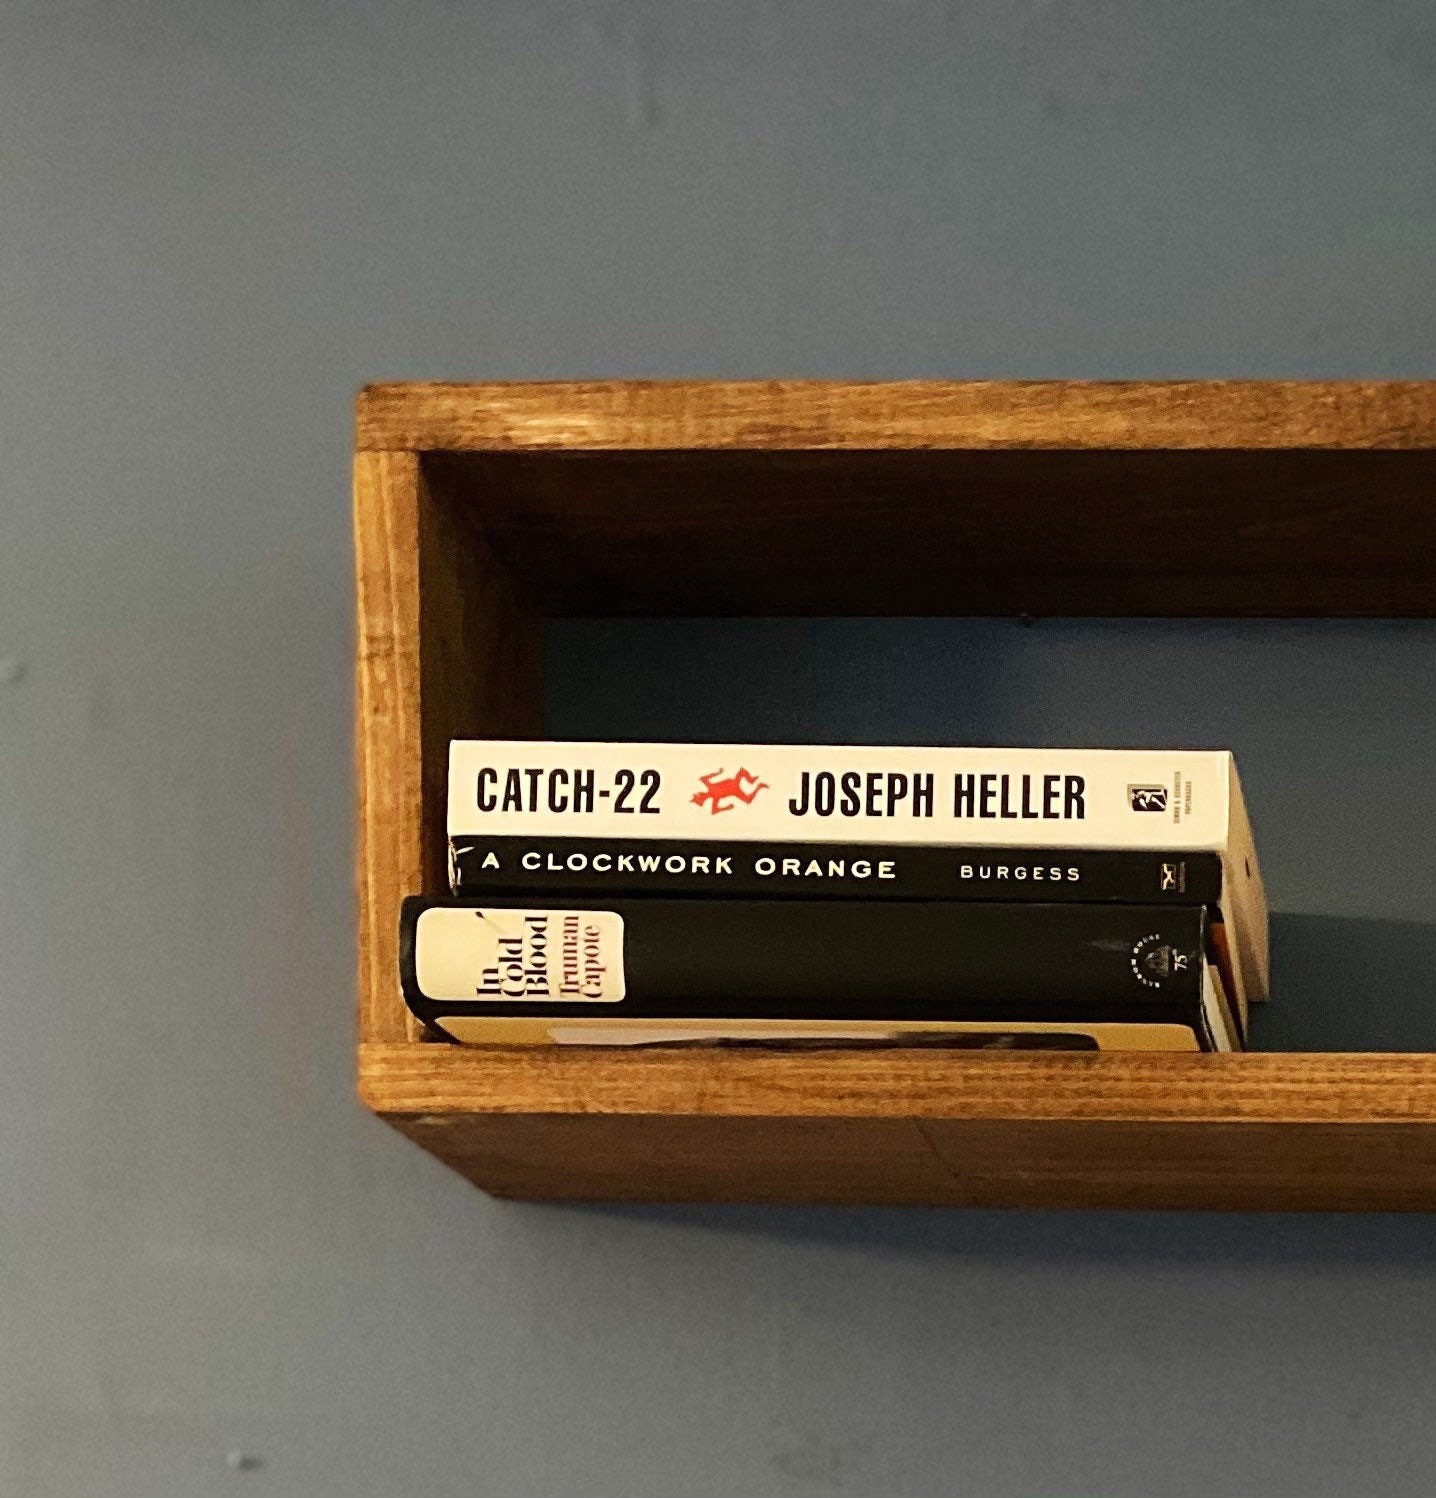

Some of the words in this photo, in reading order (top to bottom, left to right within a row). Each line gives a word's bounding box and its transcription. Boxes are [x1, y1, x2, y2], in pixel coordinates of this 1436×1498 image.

[477, 768, 661, 814] CATCH-22
[788, 771, 934, 817] JOSEPH
[953, 773, 1086, 820] HELLER
[481, 852, 500, 870] A
[521, 852, 733, 875] CLOCKWORK
[755, 857, 896, 878] ORANGE
[960, 865, 1080, 882] BURGESS
[476, 967, 501, 997] In
[498, 937, 525, 998] Cold
[524, 915, 550, 997] Blood
[558, 915, 580, 998] Truman
[580, 925, 607, 999] Capote
